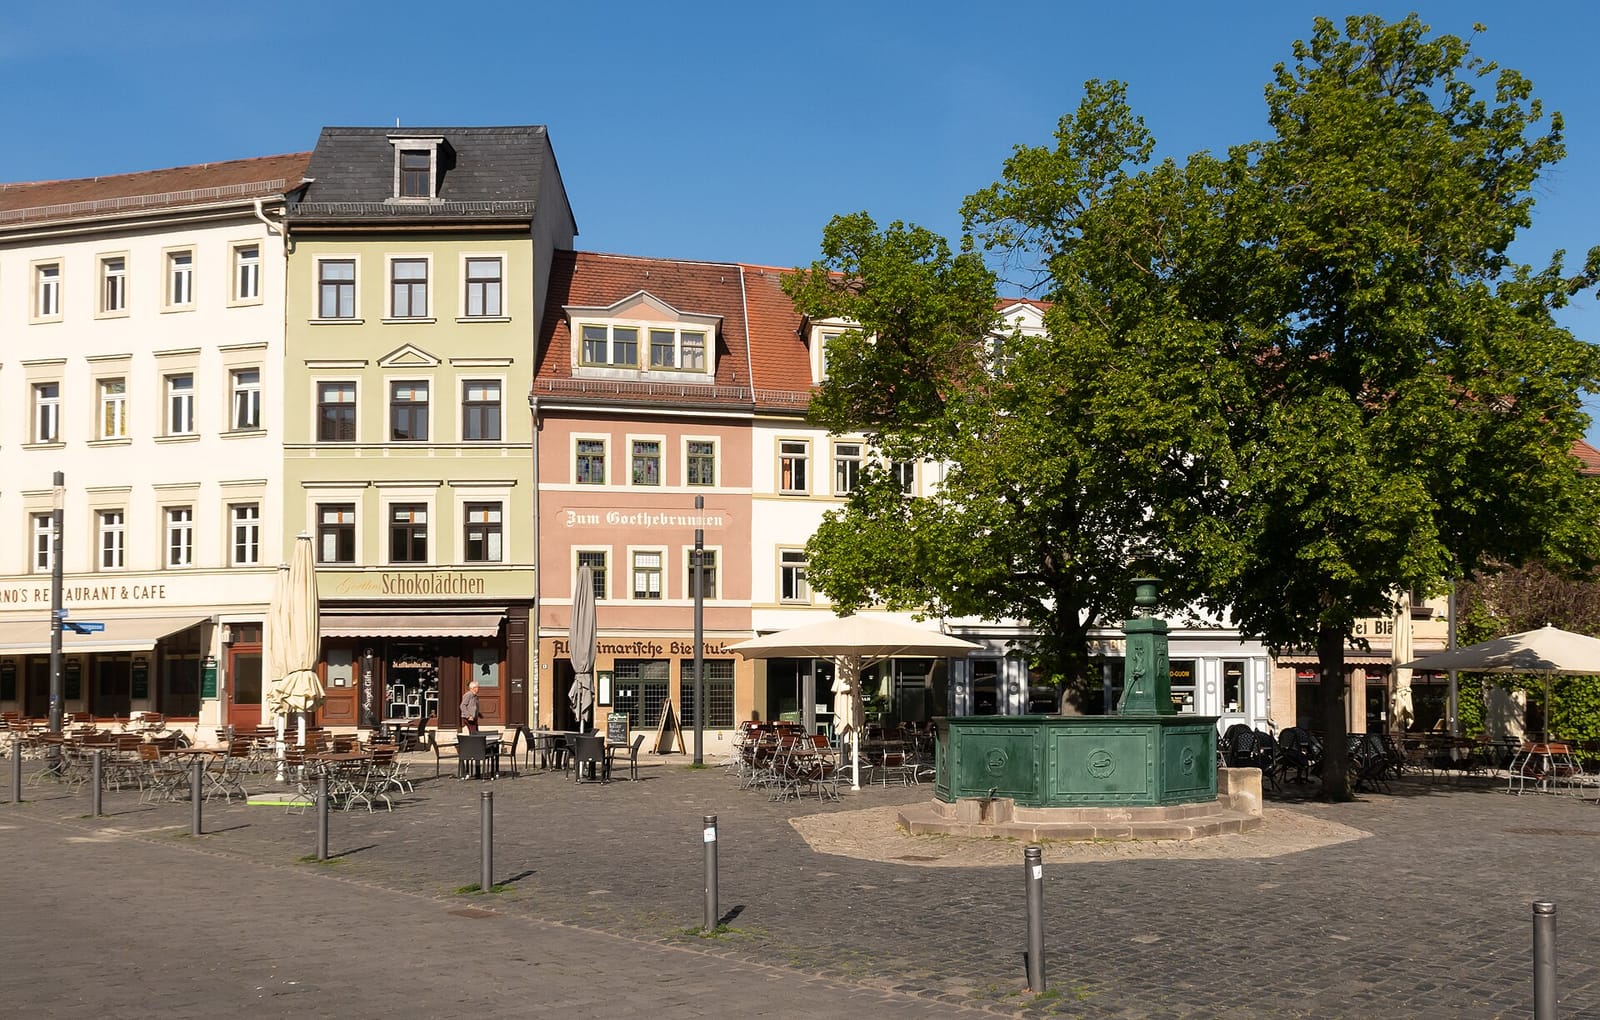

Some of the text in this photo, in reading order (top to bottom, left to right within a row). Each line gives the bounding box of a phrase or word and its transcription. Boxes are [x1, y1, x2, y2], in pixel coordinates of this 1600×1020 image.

[566, 510, 723, 528] Zum Goethebrunnen
[382, 573, 485, 595] Schokolädchen
[0, 585, 166, 603] NO'S REAURANT & CAFE
[553, 640, 735, 658] Alimarische Biertube
